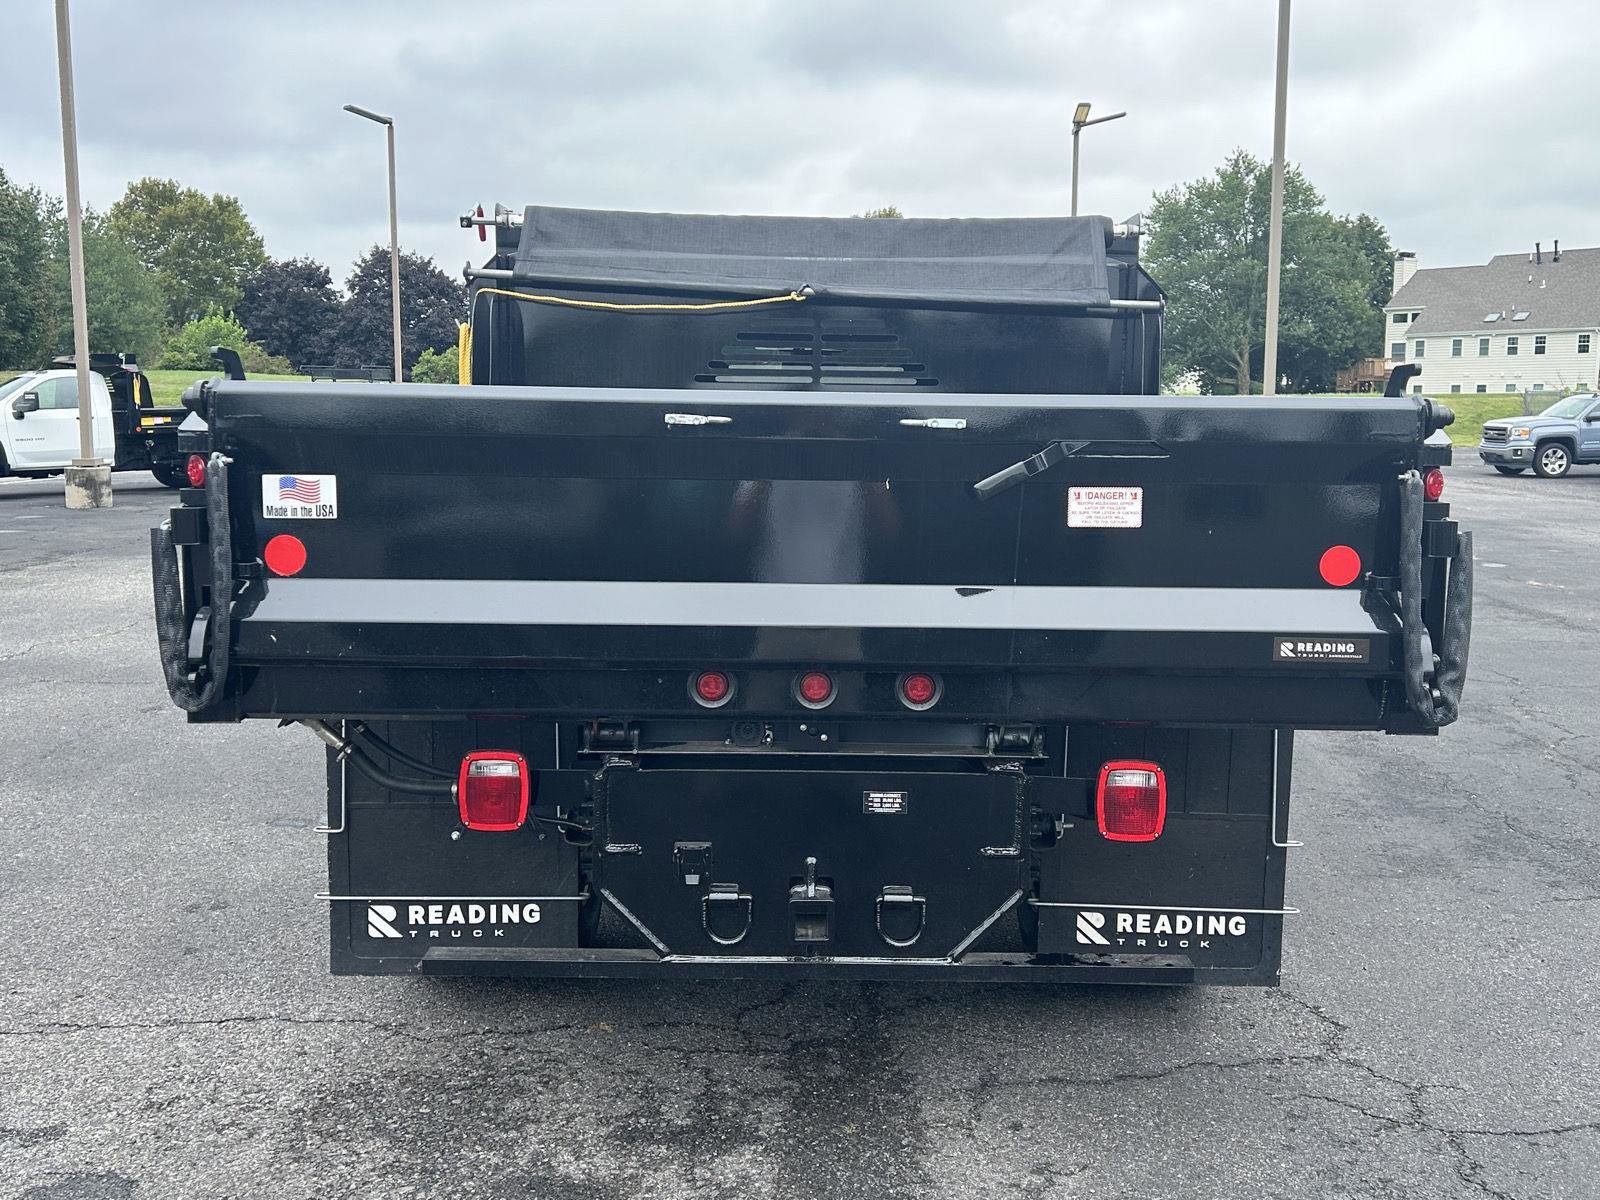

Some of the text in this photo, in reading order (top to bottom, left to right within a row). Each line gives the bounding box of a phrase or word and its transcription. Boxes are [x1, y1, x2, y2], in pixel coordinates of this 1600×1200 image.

[266, 504, 334, 517] Made in the USA
[1297, 642, 1355, 653] READING
[408, 903, 541, 925] READING
[1116, 912, 1246, 936] READING
[408, 929, 504, 938] TRUCK
[1117, 938, 1210, 948] TRUCK
